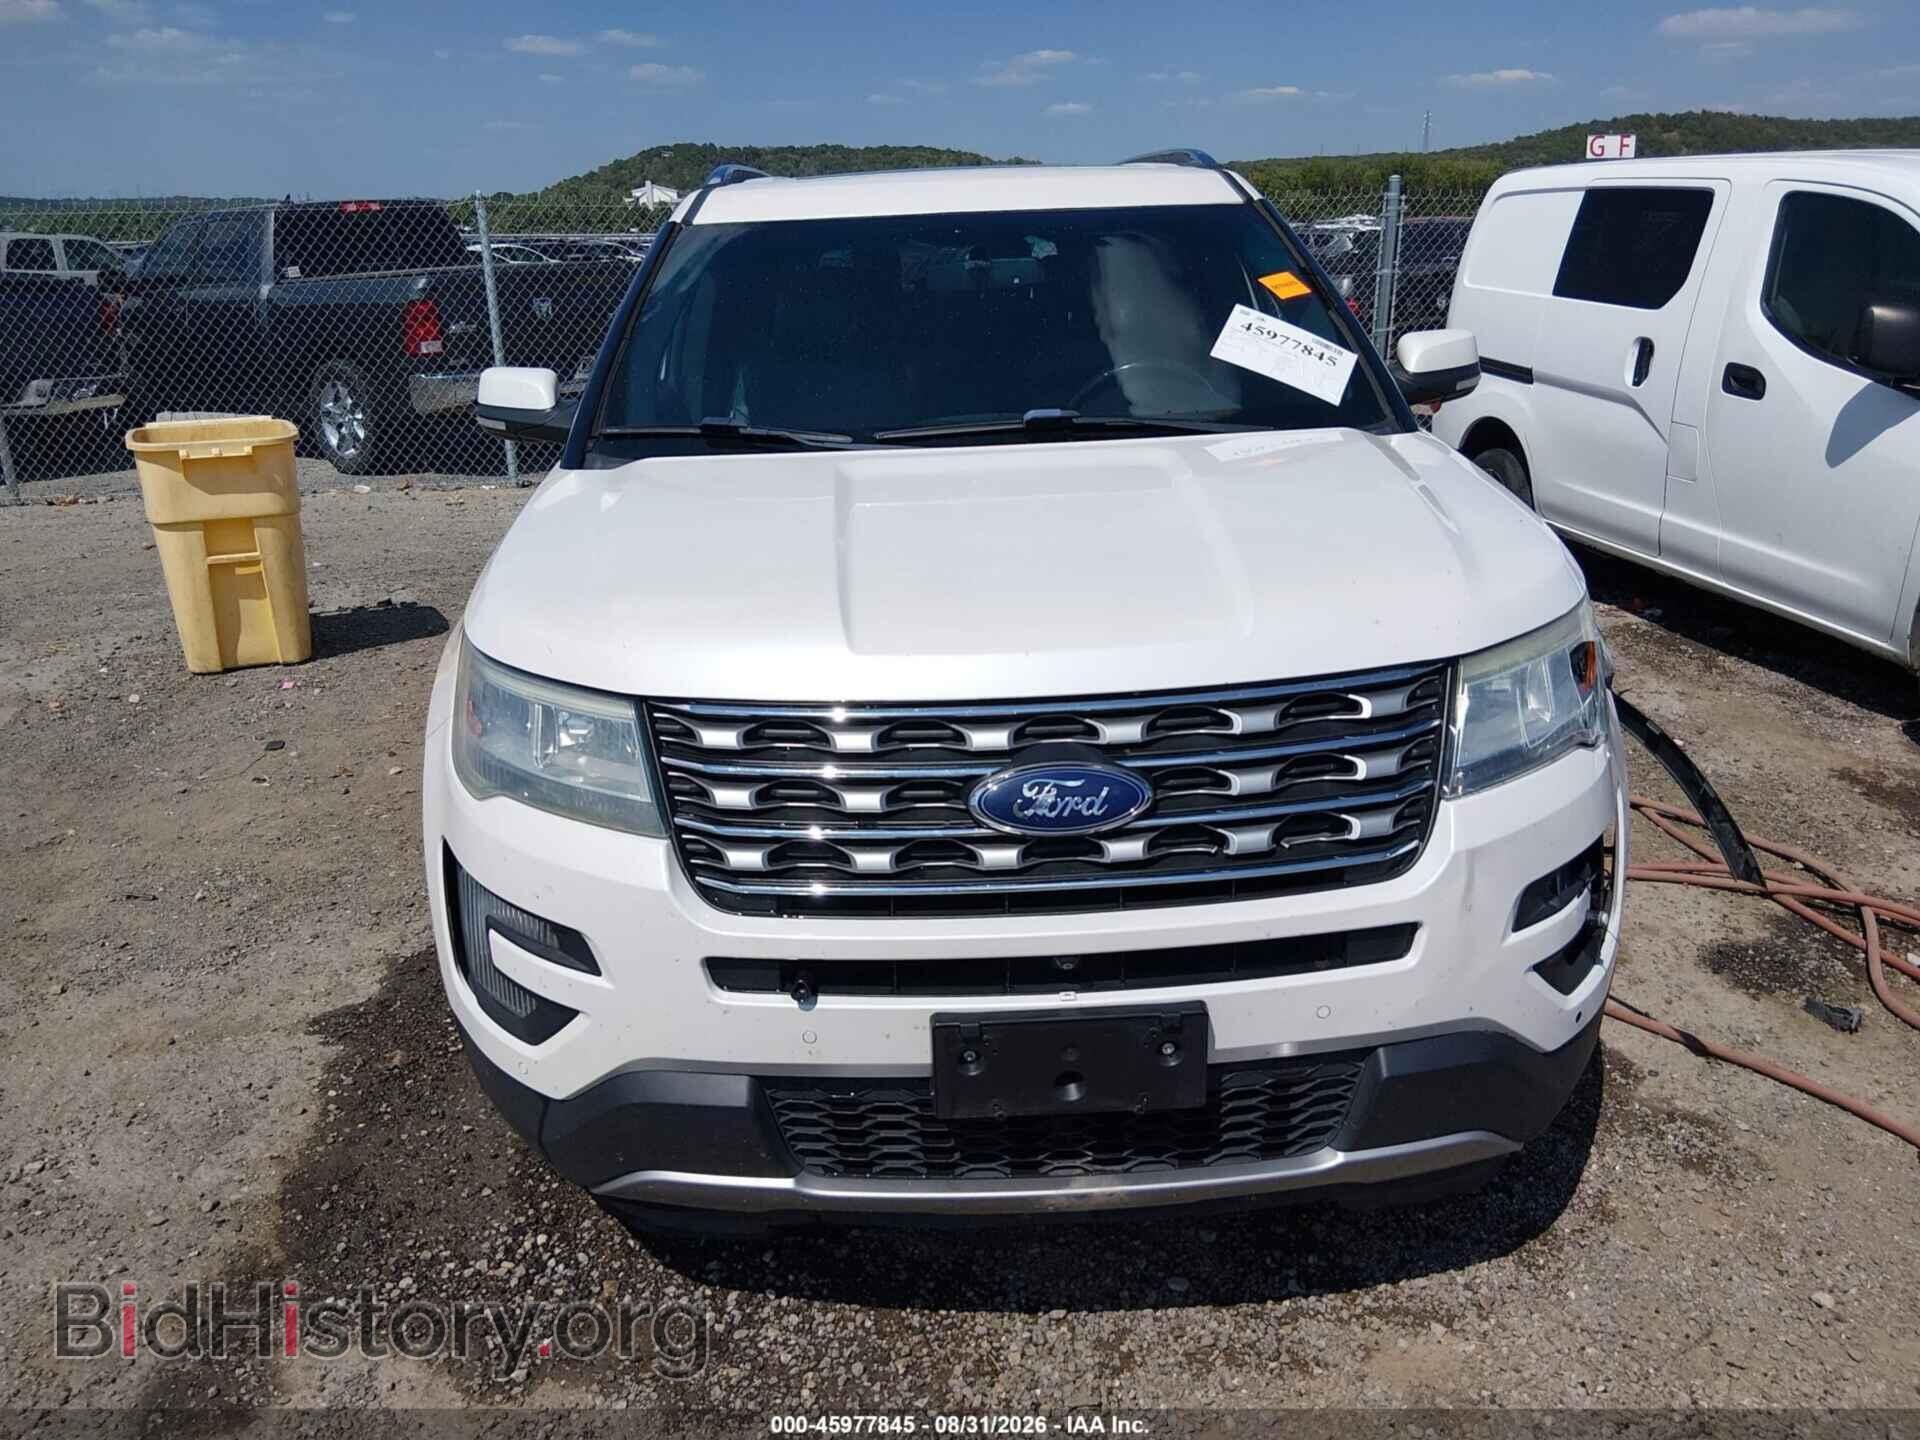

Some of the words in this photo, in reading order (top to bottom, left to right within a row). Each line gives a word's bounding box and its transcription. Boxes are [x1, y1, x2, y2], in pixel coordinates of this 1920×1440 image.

[1590, 135, 1605, 157] G
[1619, 134, 1631, 157] F
[1240, 321, 1338, 367] 45977845
[1012, 778, 1110, 819] Ford
